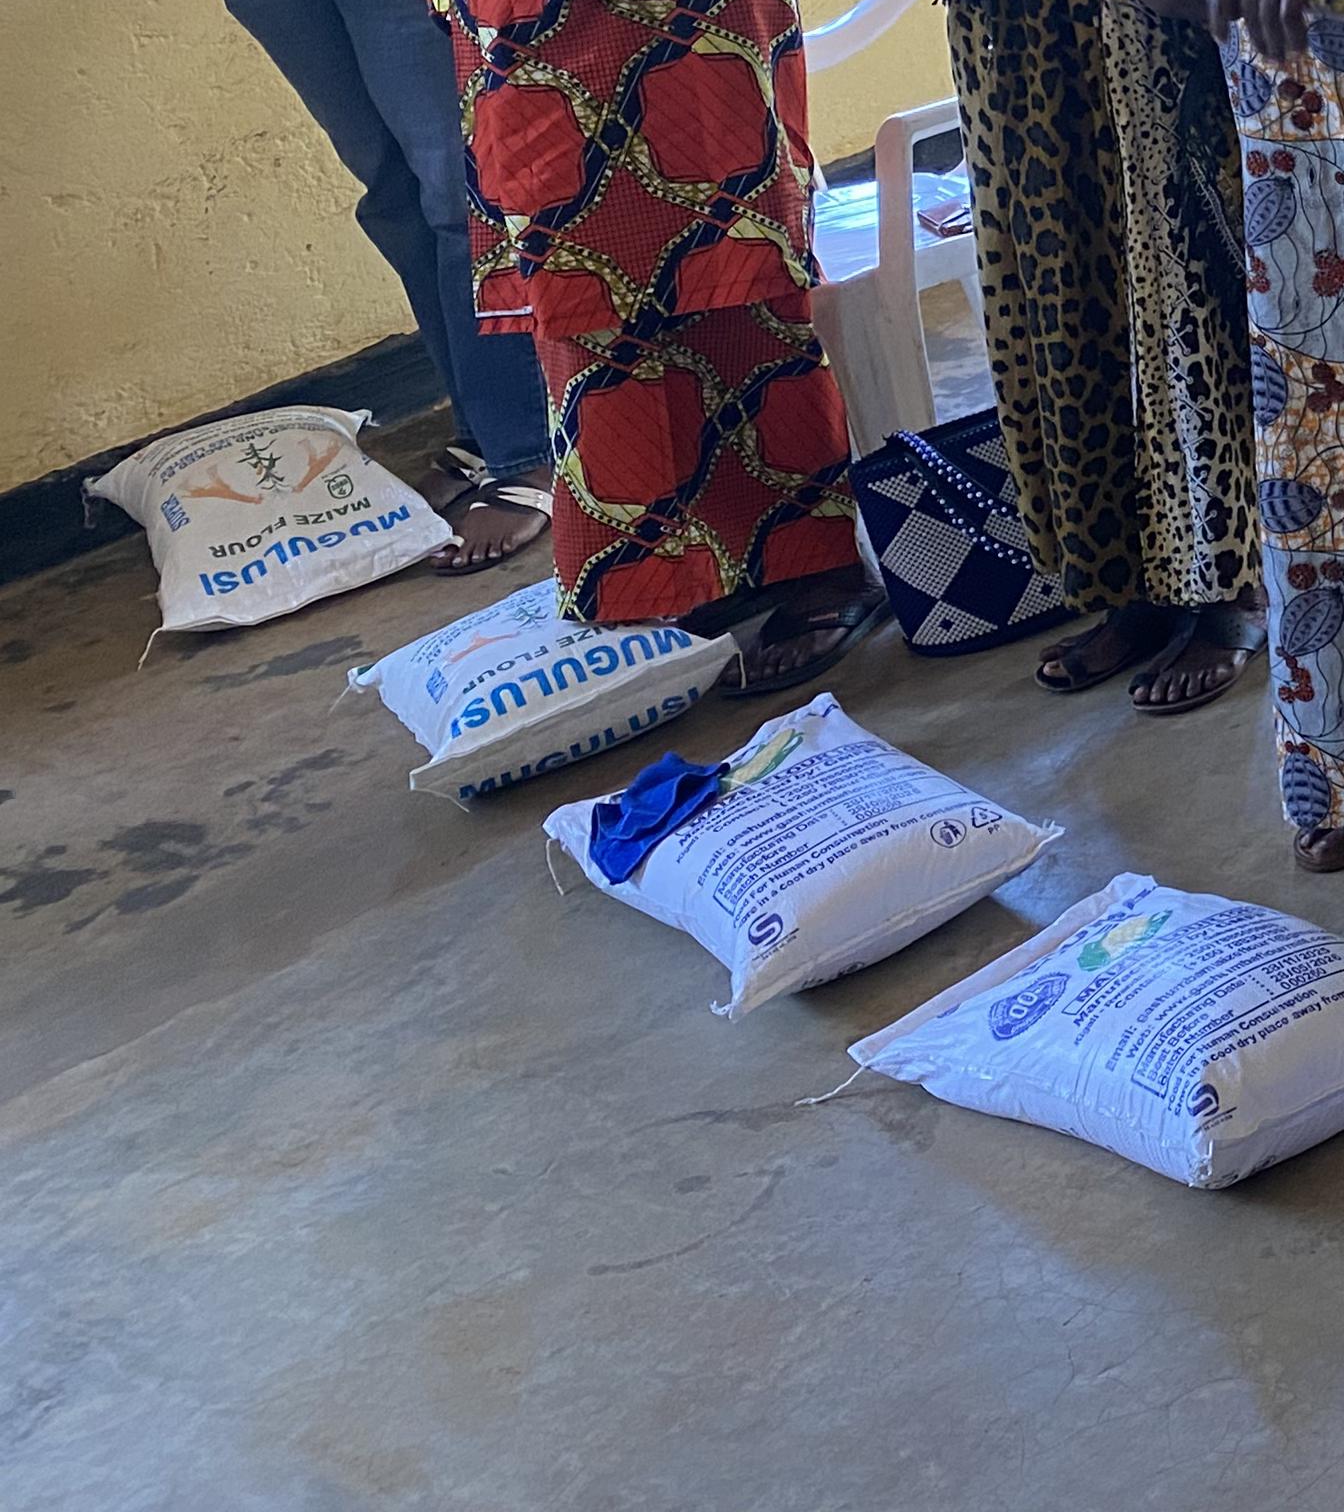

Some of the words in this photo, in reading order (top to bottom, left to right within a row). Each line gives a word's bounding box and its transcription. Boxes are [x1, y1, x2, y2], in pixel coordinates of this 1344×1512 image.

[160, 493, 191, 532] SUPER
[209, 516, 286, 558] FLOUR
[295, 496, 371, 526] MAIZE
[199, 505, 412, 596] MUGULUSI
[451, 630, 692, 738] MUGULUSI
[462, 646, 549, 693] FLOUR
[459, 687, 699, 799] MUGULUSI
[716, 828, 796, 895] Manufacturing
[759, 841, 809, 874] Number
[768, 855, 812, 884] Human
[809, 816, 888, 861] Consumption
[777, 871, 804, 891] cool
[803, 859, 825, 876] dry
[825, 842, 858, 865] place
[858, 826, 889, 845] away
[889, 816, 919, 832] from
[1105, 1024, 1137, 1071] Email:
[1137, 996, 1215, 1076] Manufacturing
[1184, 1009, 1235, 1046] Number
[1197, 1027, 1240, 1053] Human
[1209, 1042, 1236, 1063] cool
[1236, 1033, 1257, 1048] dry
[1258, 1016, 1290, 1040] place
[1291, 1001, 1322, 1020] away
